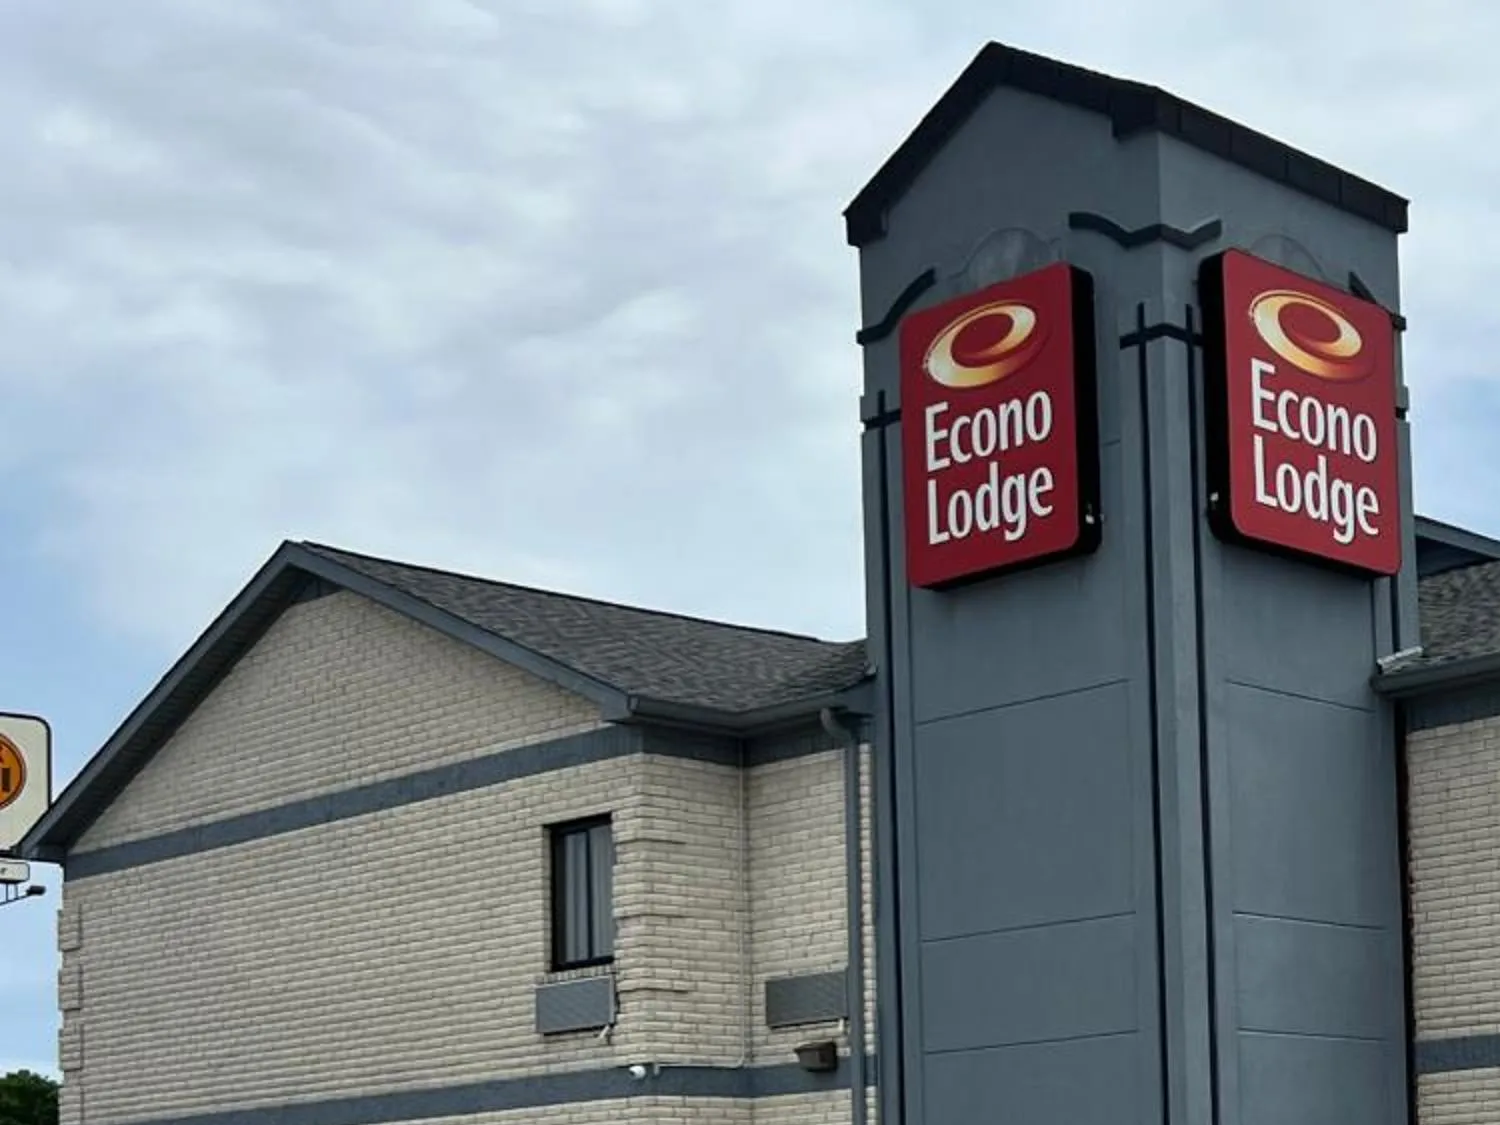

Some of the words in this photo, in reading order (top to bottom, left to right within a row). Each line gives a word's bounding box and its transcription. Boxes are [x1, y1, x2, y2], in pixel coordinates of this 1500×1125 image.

[926, 390, 1052, 471] Econo
[1250, 357, 1378, 463] Econo
[928, 463, 1054, 545] Lodge
[1254, 435, 1380, 545] Lodge
